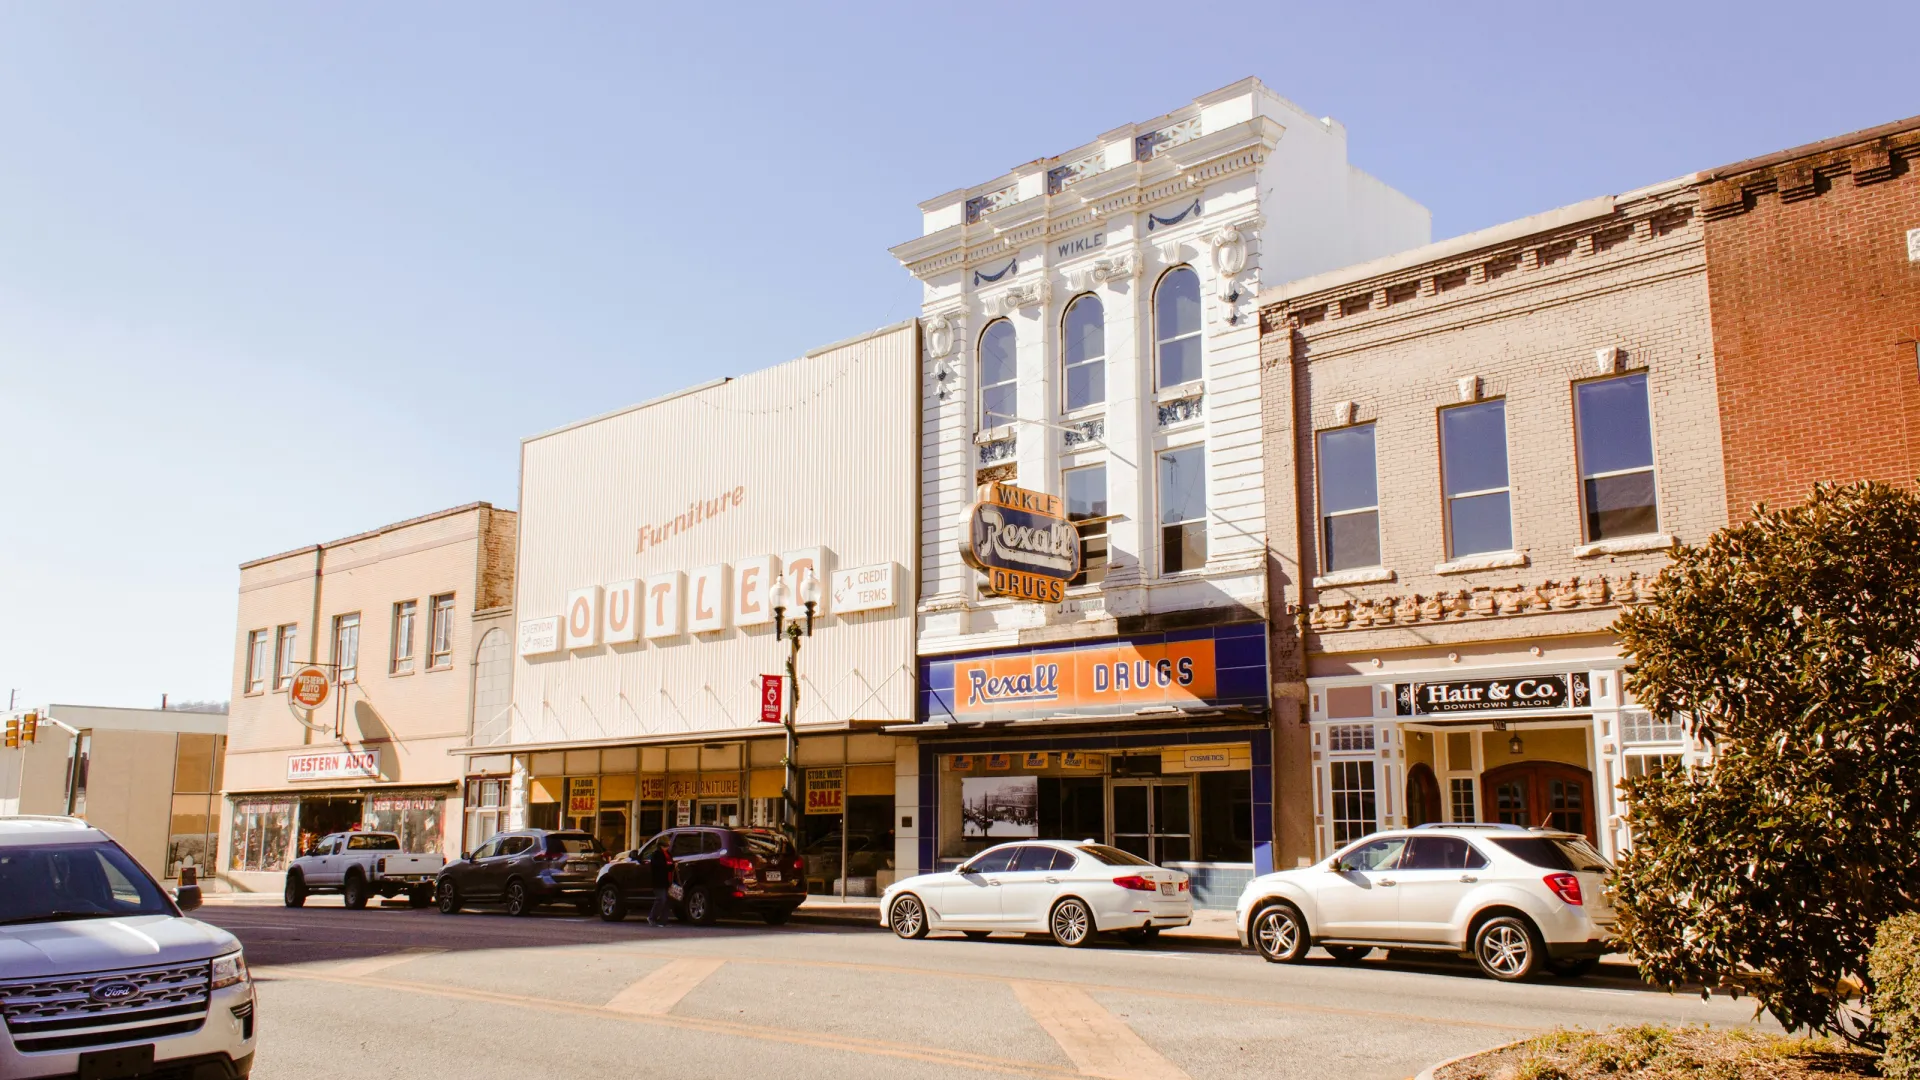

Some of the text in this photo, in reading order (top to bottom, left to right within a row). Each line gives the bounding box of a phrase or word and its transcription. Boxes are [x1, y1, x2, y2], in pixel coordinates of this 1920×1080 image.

[1057, 233, 1104, 257] WIKLE
[997, 483, 1059, 516] WIKLE
[635, 484, 745, 555] Furniture
[979, 508, 1073, 562] Rexall
[857, 568, 889, 585] CREDIT
[993, 569, 1061, 601] DRUGS
[569, 557, 814, 639] OUTLET
[857, 587, 888, 604] TERMS
[521, 621, 554, 636] EVERYDAY
[532, 636, 554, 649] PRICES
[301, 685, 320, 693] AUTO
[968, 656, 1194, 705] Rexall DRUGS
[1426, 679, 1558, 704] Hair & Co.
[1443, 701, 1508, 710] DOWNTOWN
[1512, 699, 1550, 708] SALON
[291, 755, 340, 773] WESTERN
[344, 753, 375, 769] AUTO
[1189, 753, 1225, 763] COSMETICS
[807, 769, 842, 779] STORE WIDE
[574, 779, 594, 787] FLOOR
[683, 779, 738, 796] FURNITURE
[809, 780, 841, 790] FURNITURE
[572, 788, 596, 797] SAMPLE
[808, 790, 842, 808] SALE
[571, 797, 595, 811] SALE
[104, 985, 130, 997] Ford
